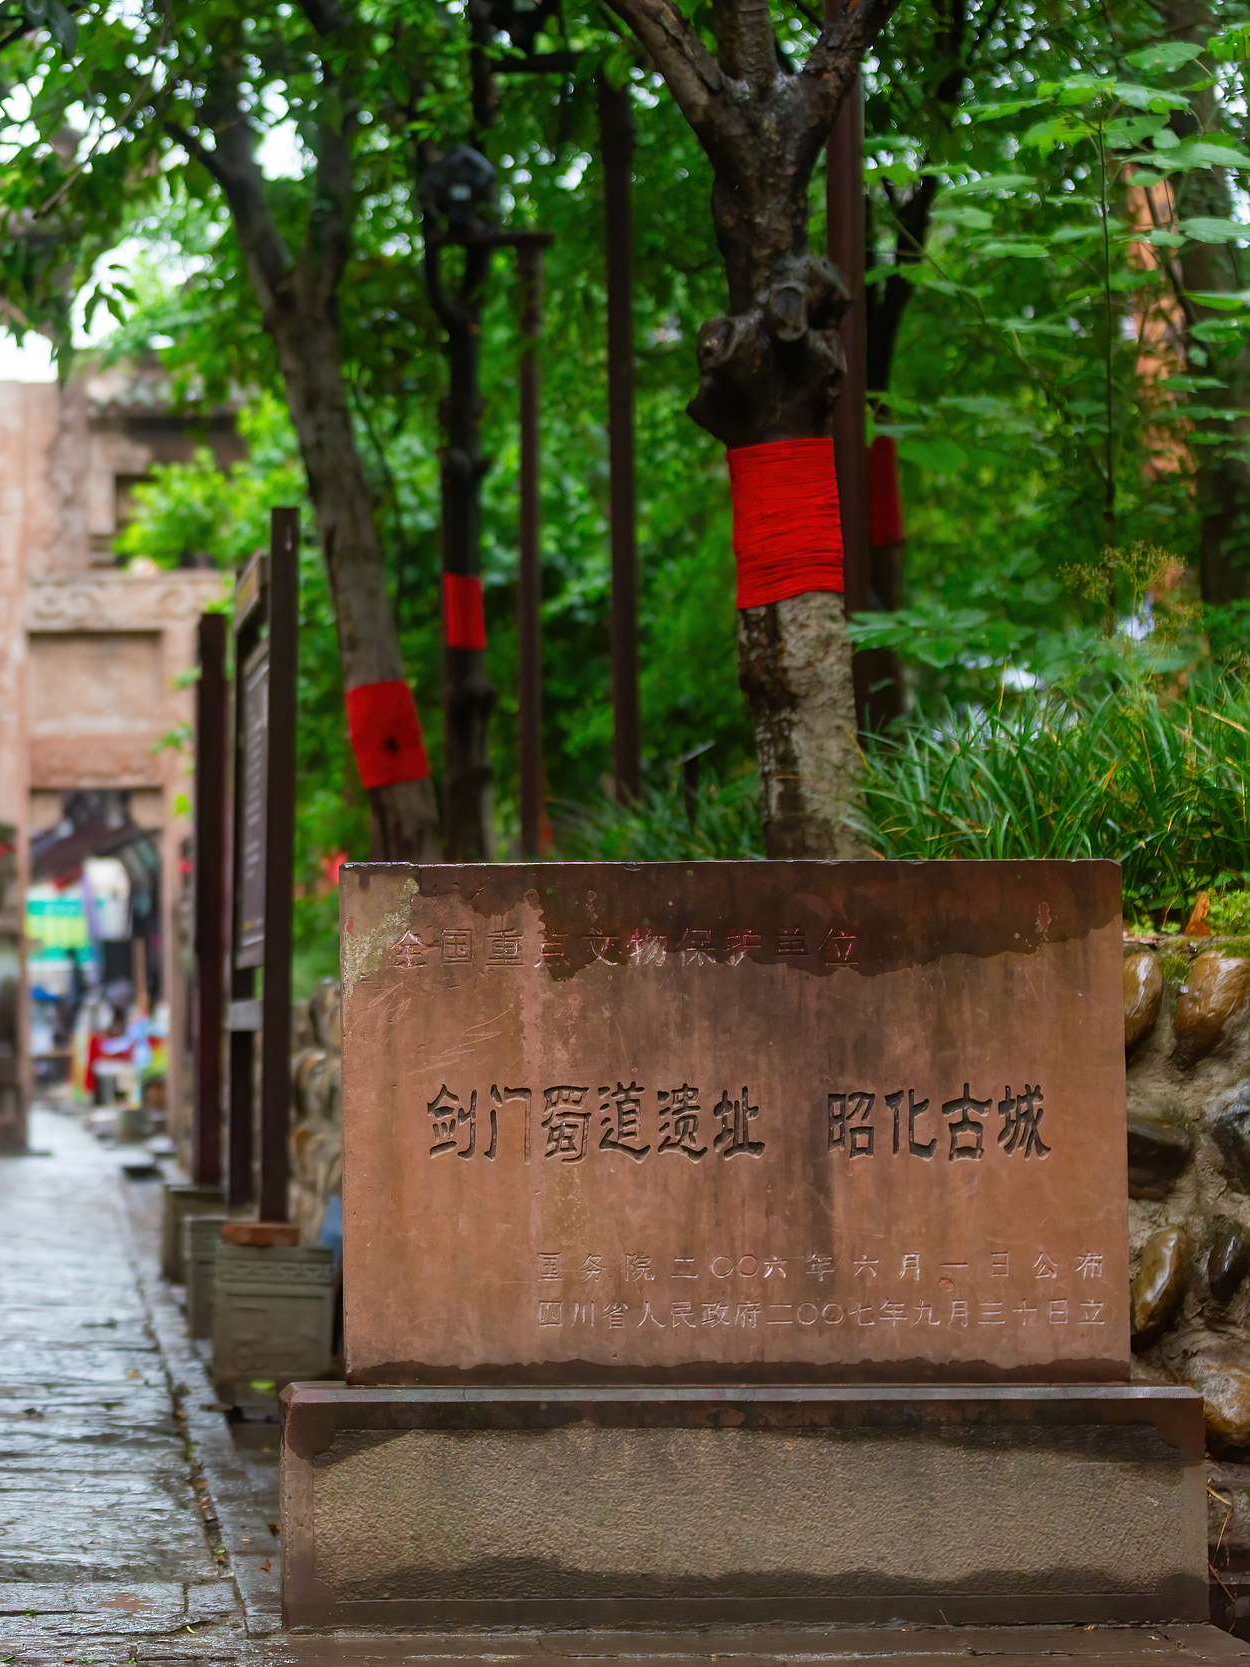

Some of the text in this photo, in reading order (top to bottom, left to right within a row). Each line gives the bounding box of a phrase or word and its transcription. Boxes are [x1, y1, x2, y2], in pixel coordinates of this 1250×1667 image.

[388, 928, 859, 968] 全国重点文物保护单位
[426, 1082, 1052, 1165] 剑门蜀道遗址 昭化古城
